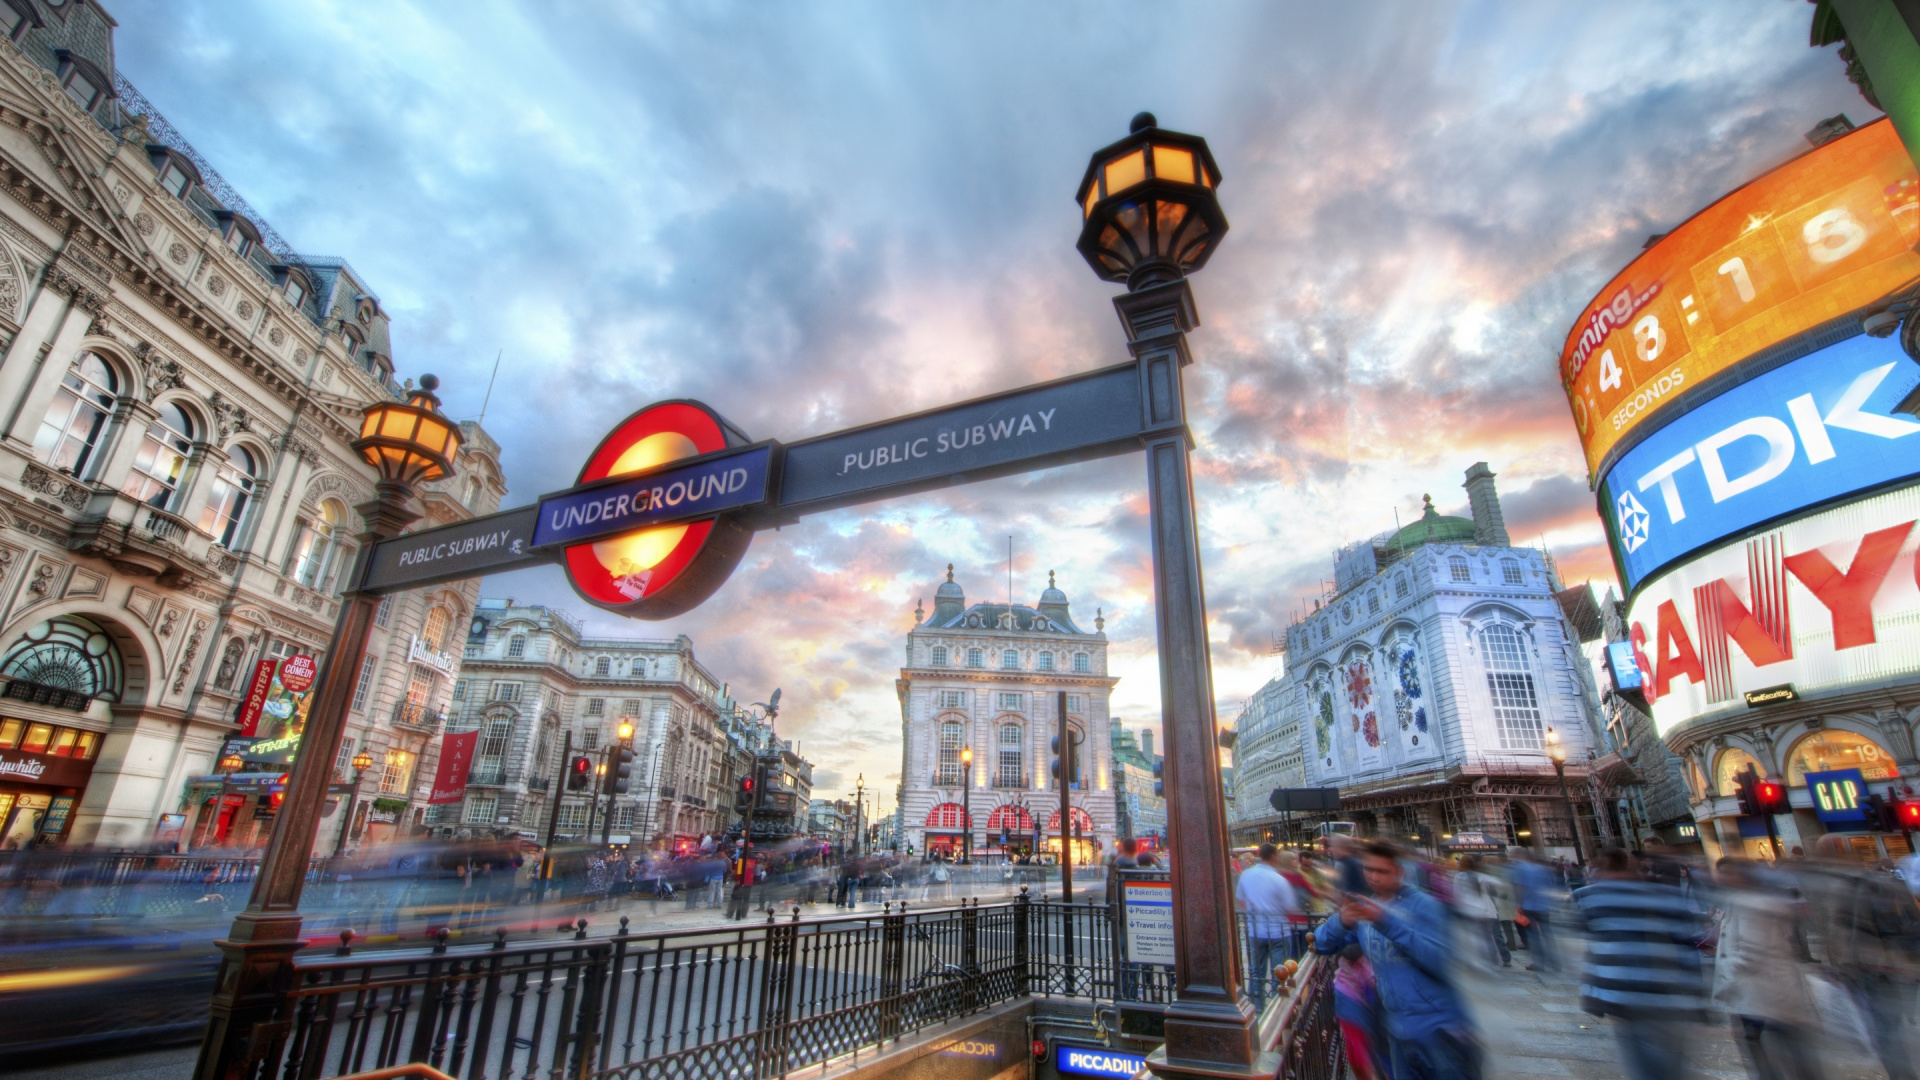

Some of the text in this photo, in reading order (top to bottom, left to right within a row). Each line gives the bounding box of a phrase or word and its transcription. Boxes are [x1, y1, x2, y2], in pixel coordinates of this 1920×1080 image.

[1612, 368, 1685, 431] SECONDS
[843, 408, 1056, 474] PUBLIC SUBWAY
[1637, 361, 1920, 525] TDK
[551, 467, 748, 531] UNDERGROUND
[399, 530, 510, 567] PUBLIC SUBWAY
[1630, 519, 1920, 706] SANY
[285, 664, 314, 679] COMEDY
[294, 656, 311, 668] BEST
[408, 634, 456, 678] Lillywhites
[252, 695, 263, 710] 39
[450, 738, 463, 784] SALE
[1816, 780, 1859, 811] GAP
[1679, 826, 1695, 837] GAP
[1135, 908, 1166, 916] Piccadilly
[1136, 921, 1173, 930] Travel infor
